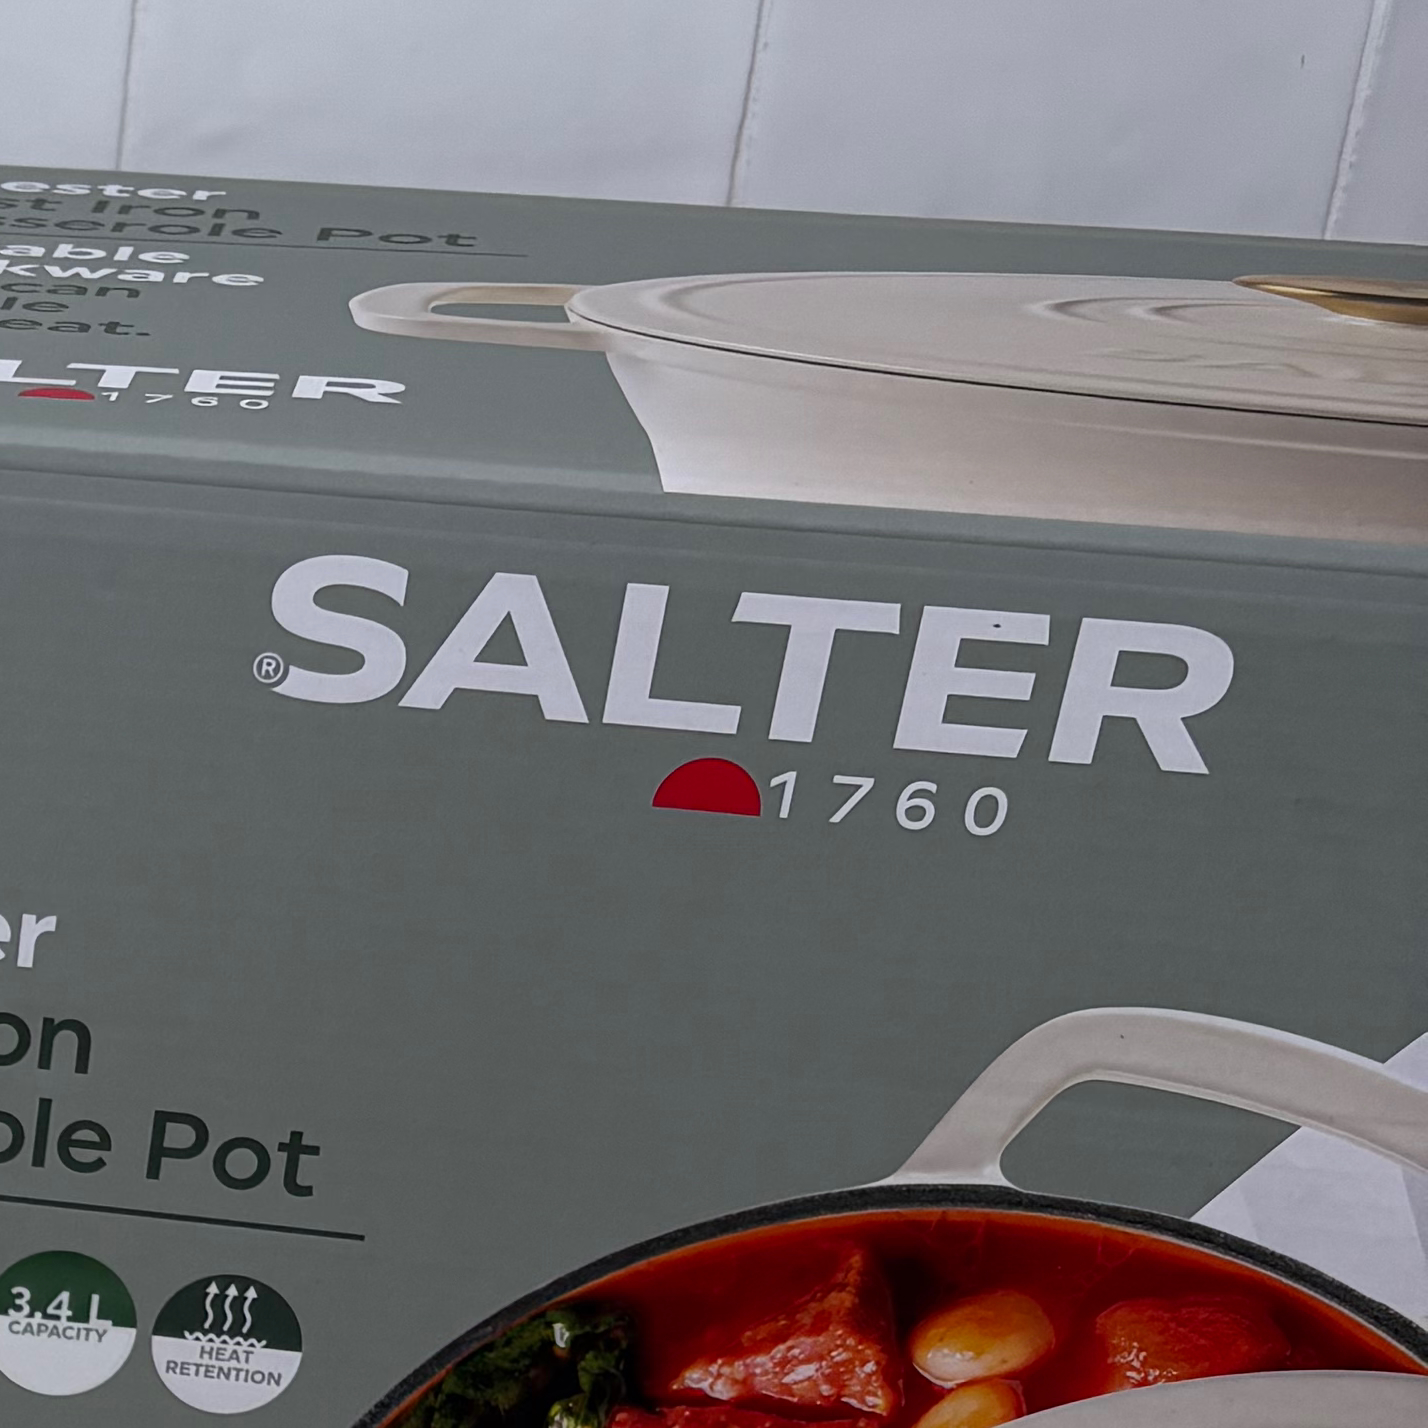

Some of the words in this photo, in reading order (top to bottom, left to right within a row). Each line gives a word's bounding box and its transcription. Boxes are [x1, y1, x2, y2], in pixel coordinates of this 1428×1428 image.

[91, 200, 260, 220] Iron
[316, 227, 478, 248] Pot
[0, 282, 141, 299] can
[99, 390, 270, 410] 1760
[269, 553, 1236, 775] SALTER
[768, 771, 1008, 837] 1760
[146, 1109, 321, 1198] Pot
[8, 1286, 73, 1323] 3.4
[88, 1293, 113, 1327] L
[8, 1320, 108, 1343] CAPACITY
[199, 1345, 255, 1365] HEAT
[165, 1360, 283, 1387] RETENTION
